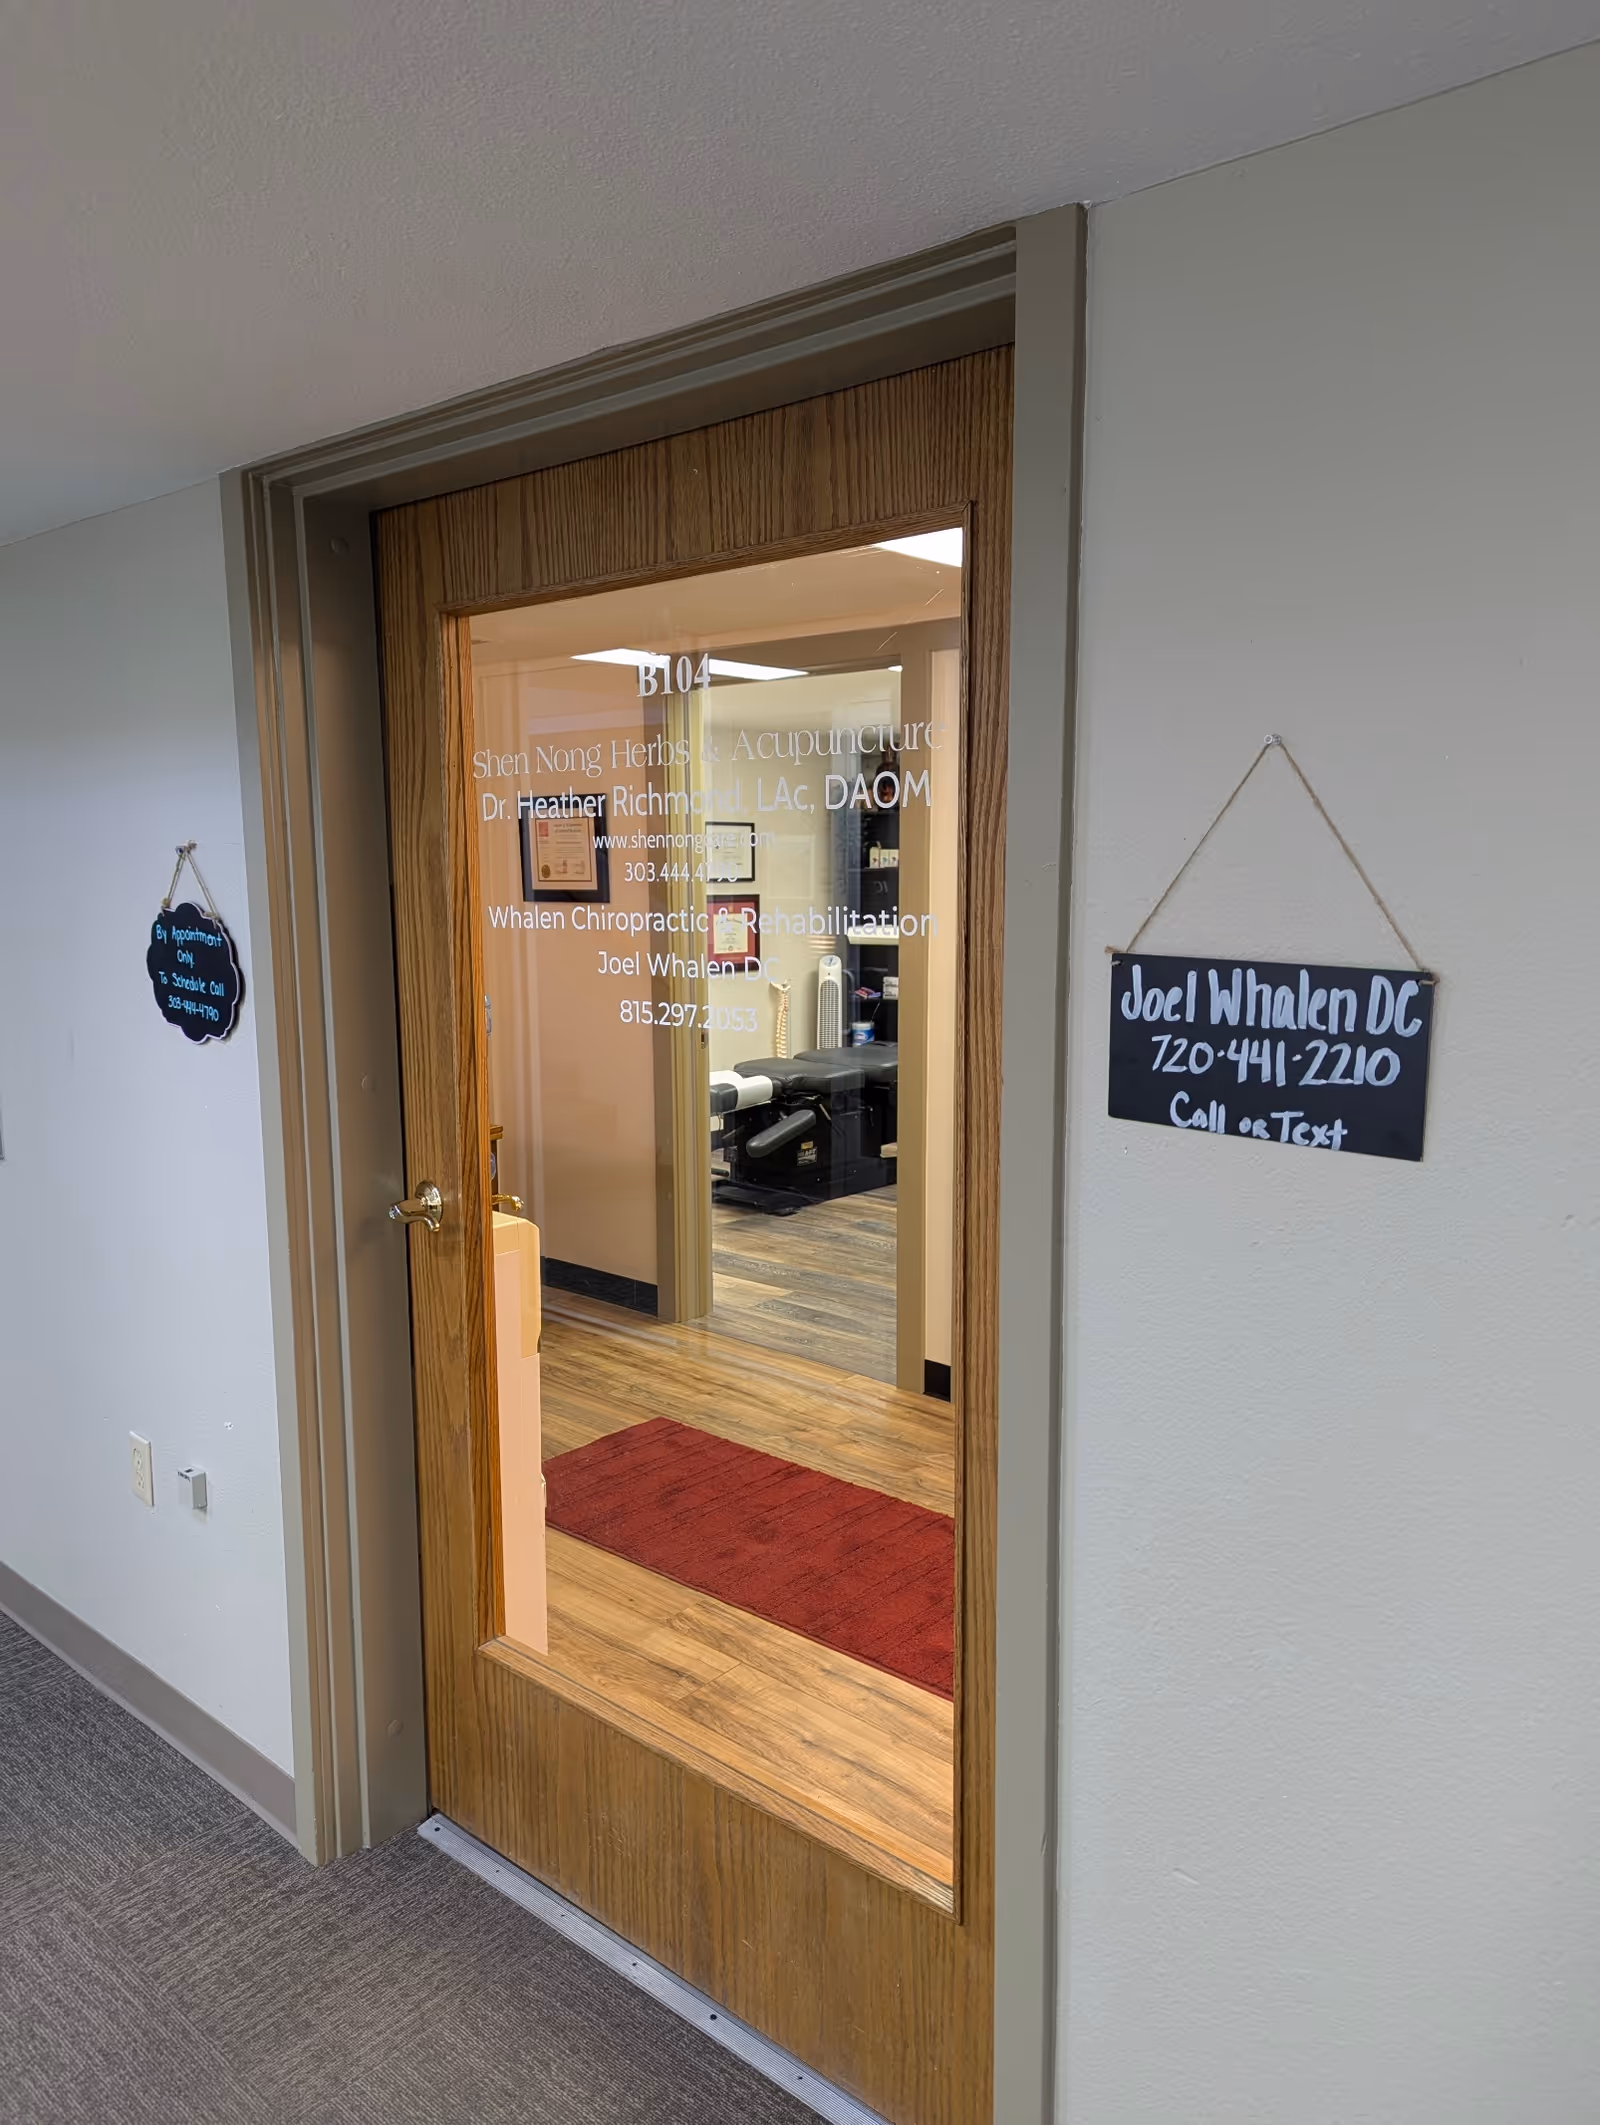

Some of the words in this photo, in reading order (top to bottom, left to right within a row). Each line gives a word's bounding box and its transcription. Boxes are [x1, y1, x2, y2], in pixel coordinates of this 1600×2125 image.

[637, 653, 711, 698] B104
[473, 749, 529, 779] Shen
[536, 744, 602, 778] Nong
[611, 733, 690, 768] Herbs
[731, 720, 945, 766] Acupuncture
[482, 792, 511, 821] Dr.
[517, 785, 606, 820] Heather
[757, 776, 815, 815] LAc,
[825, 769, 932, 810] DAOM
[156, 924, 167, 944] By
[172, 925, 223, 947] Appointment
[488, 905, 565, 930] Whalen
[571, 905, 709, 937] Chiropractic
[718, 907, 735, 933] &
[740, 906, 939, 937] Rehabilitation
[598, 951, 640, 976] Joel
[647, 953, 735, 980] Whalen
[744, 956, 781, 982] DC
[158, 971, 168, 984] To
[171, 972, 206, 994] Schedule
[209, 980, 225, 997] Call
[168, 994, 220, 1022] 303-444-4790
[620, 1000, 759, 1032] 815.297.2053
[1121, 964, 1198, 1023] Joel
[1208, 968, 1358, 1035] Whalen
[1366, 975, 1423, 1037] DC
[1169, 1090, 1226, 1135] Call
[1270, 1111, 1349, 1151] Text
